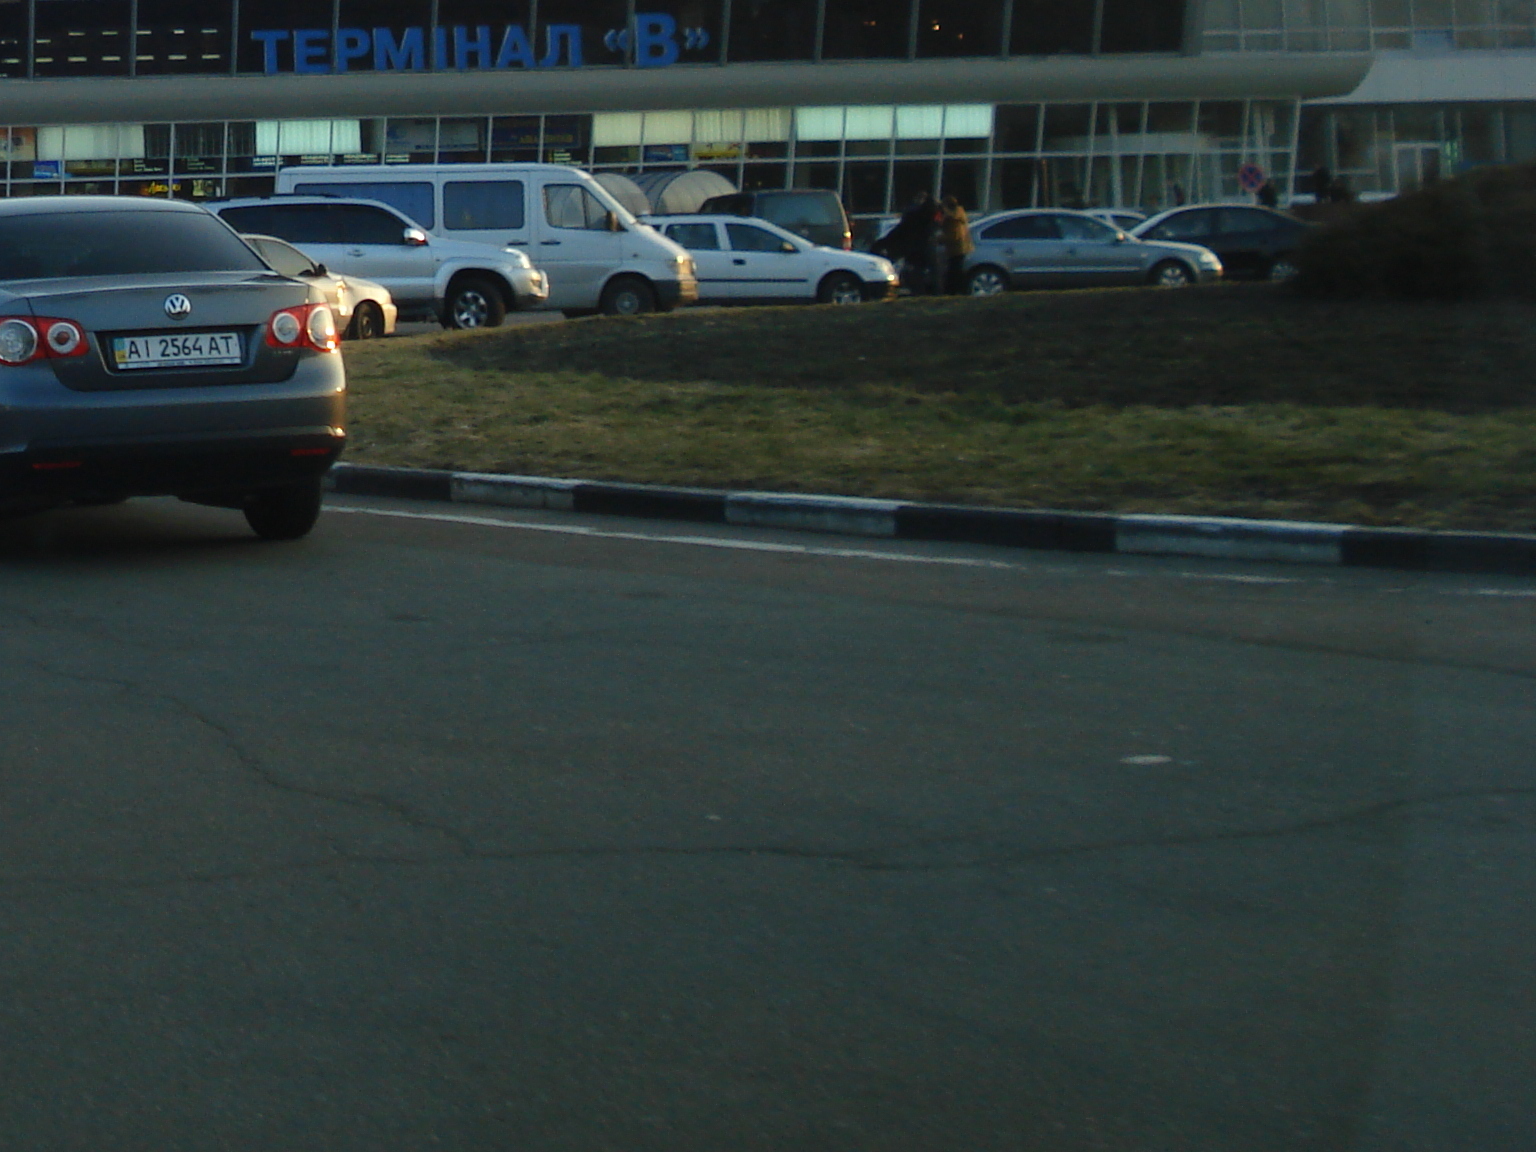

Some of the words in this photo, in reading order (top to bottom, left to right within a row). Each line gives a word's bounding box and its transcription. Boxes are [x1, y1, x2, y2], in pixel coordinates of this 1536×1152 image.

[251, 24, 583, 76] ТЕРМІНАЛ
[128, 340, 151, 359] AI
[159, 337, 203, 358] 2564
[208, 336, 233, 355] AT
